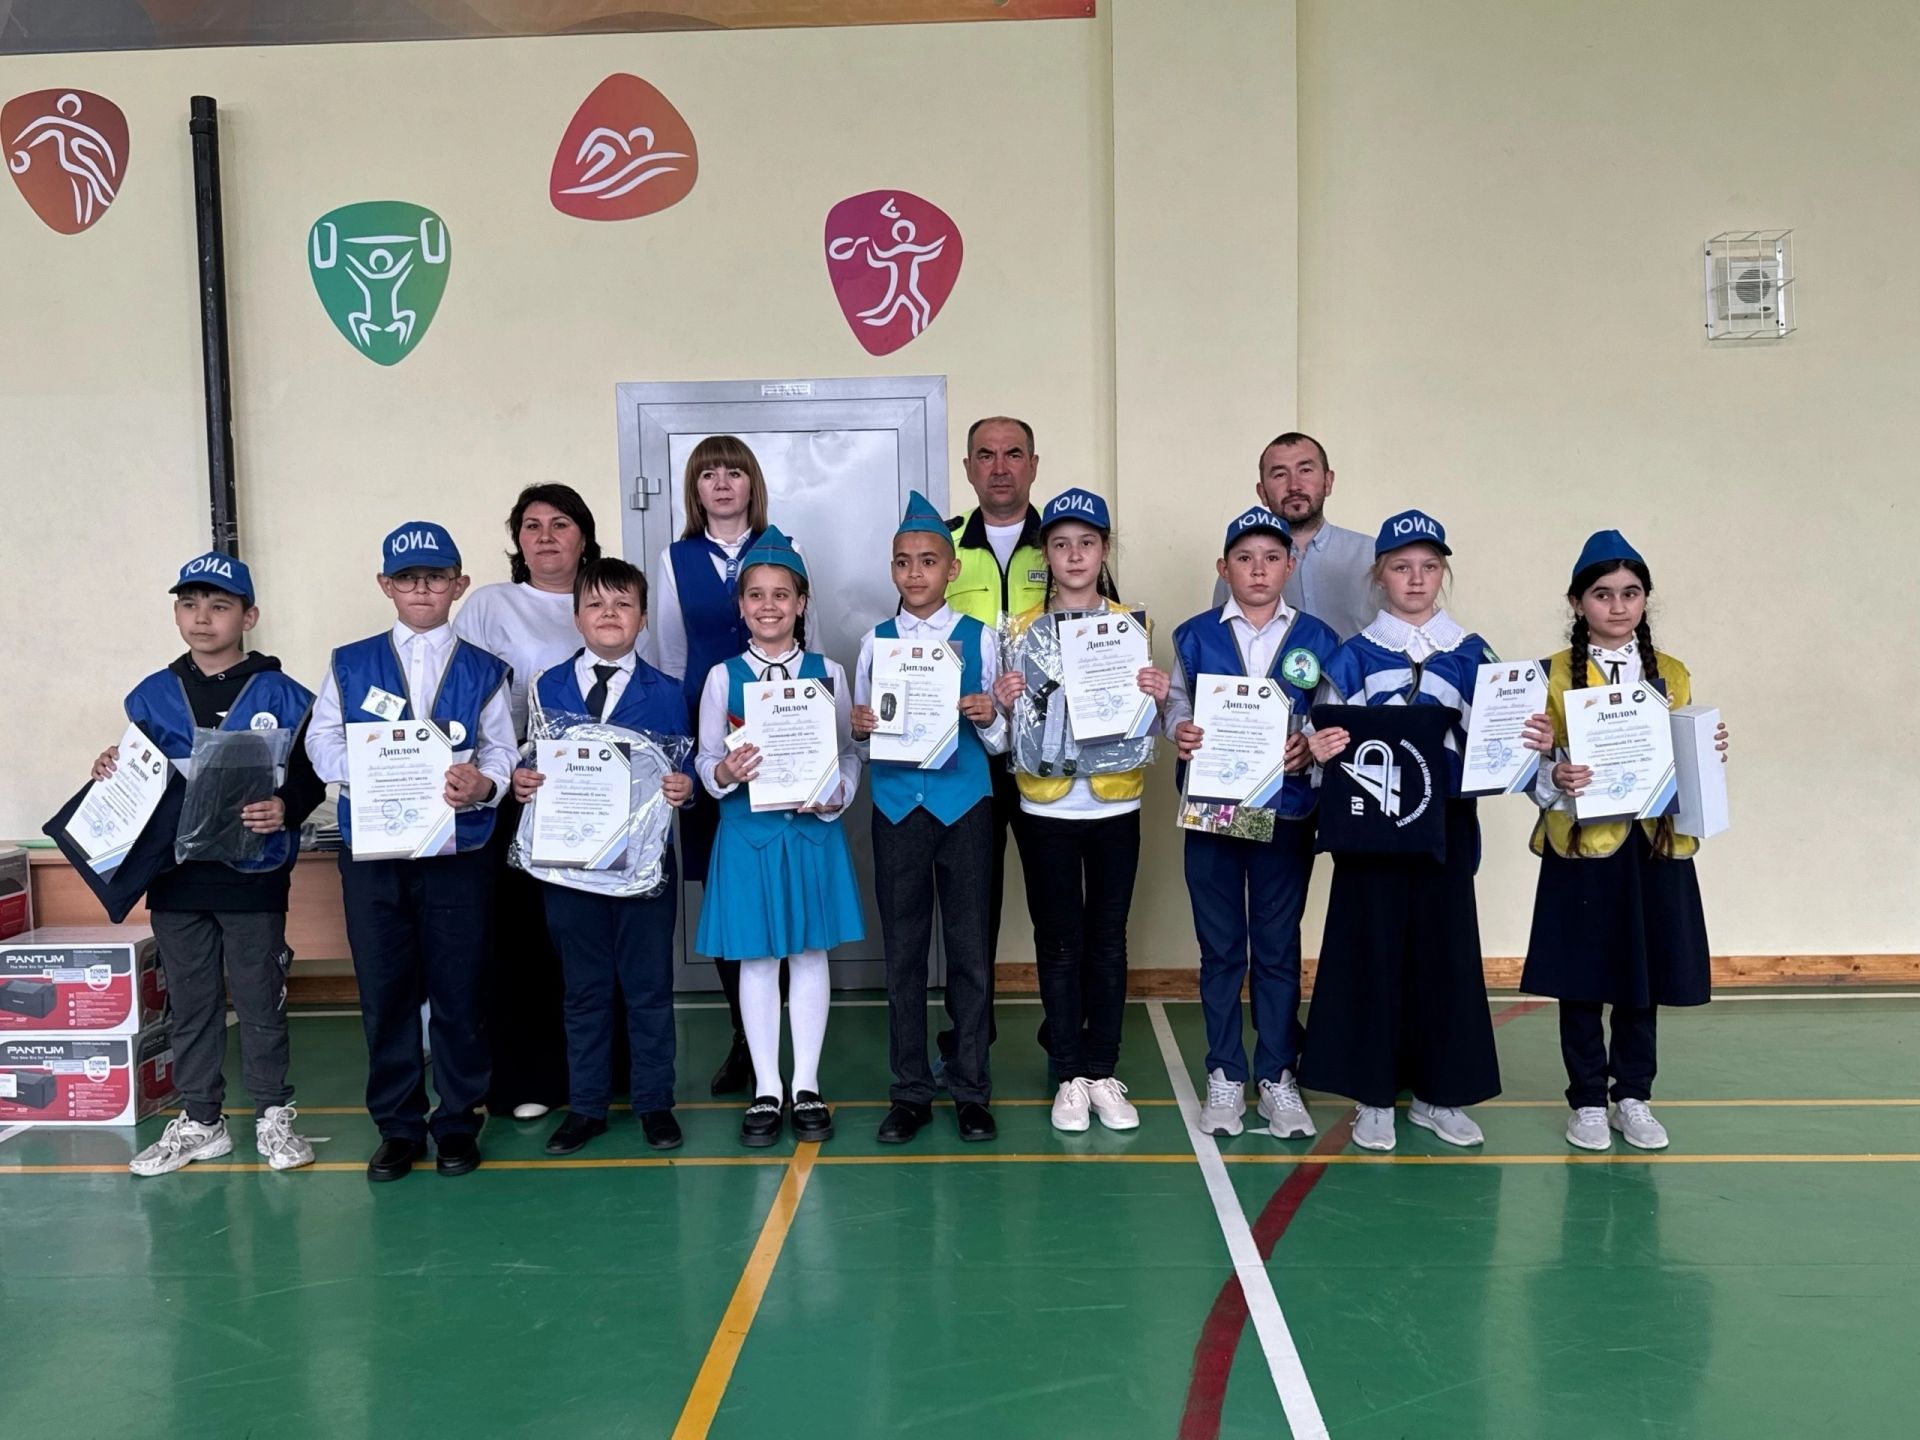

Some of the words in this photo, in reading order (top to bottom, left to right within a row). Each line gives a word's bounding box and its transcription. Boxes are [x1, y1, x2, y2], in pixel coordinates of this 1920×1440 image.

[1052, 494, 1095, 515] ЮИД
[1238, 512, 1282, 530] ЮИД
[1393, 516, 1438, 538] ЮИД
[391, 530, 439, 556] ЮИД
[185, 556, 232, 579] ЮИД
[1029, 572, 1046, 581] ДПС
[1086, 639, 1121, 651] Диплом
[899, 662, 935, 673] Диплом
[1495, 687, 1526, 699] Диплом
[772, 704, 808, 715] Диплом
[1222, 699, 1260, 711] Диплом
[1596, 709, 1638, 722] Диплом
[378, 747, 420, 758] Диплом
[126, 757, 149, 783] Диплом
[564, 762, 602, 773] Диплом
[1351, 796, 1365, 816] ГБУ
[6, 954, 65, 964] PANTUM
[7, 1046, 65, 1055] PANTUM
